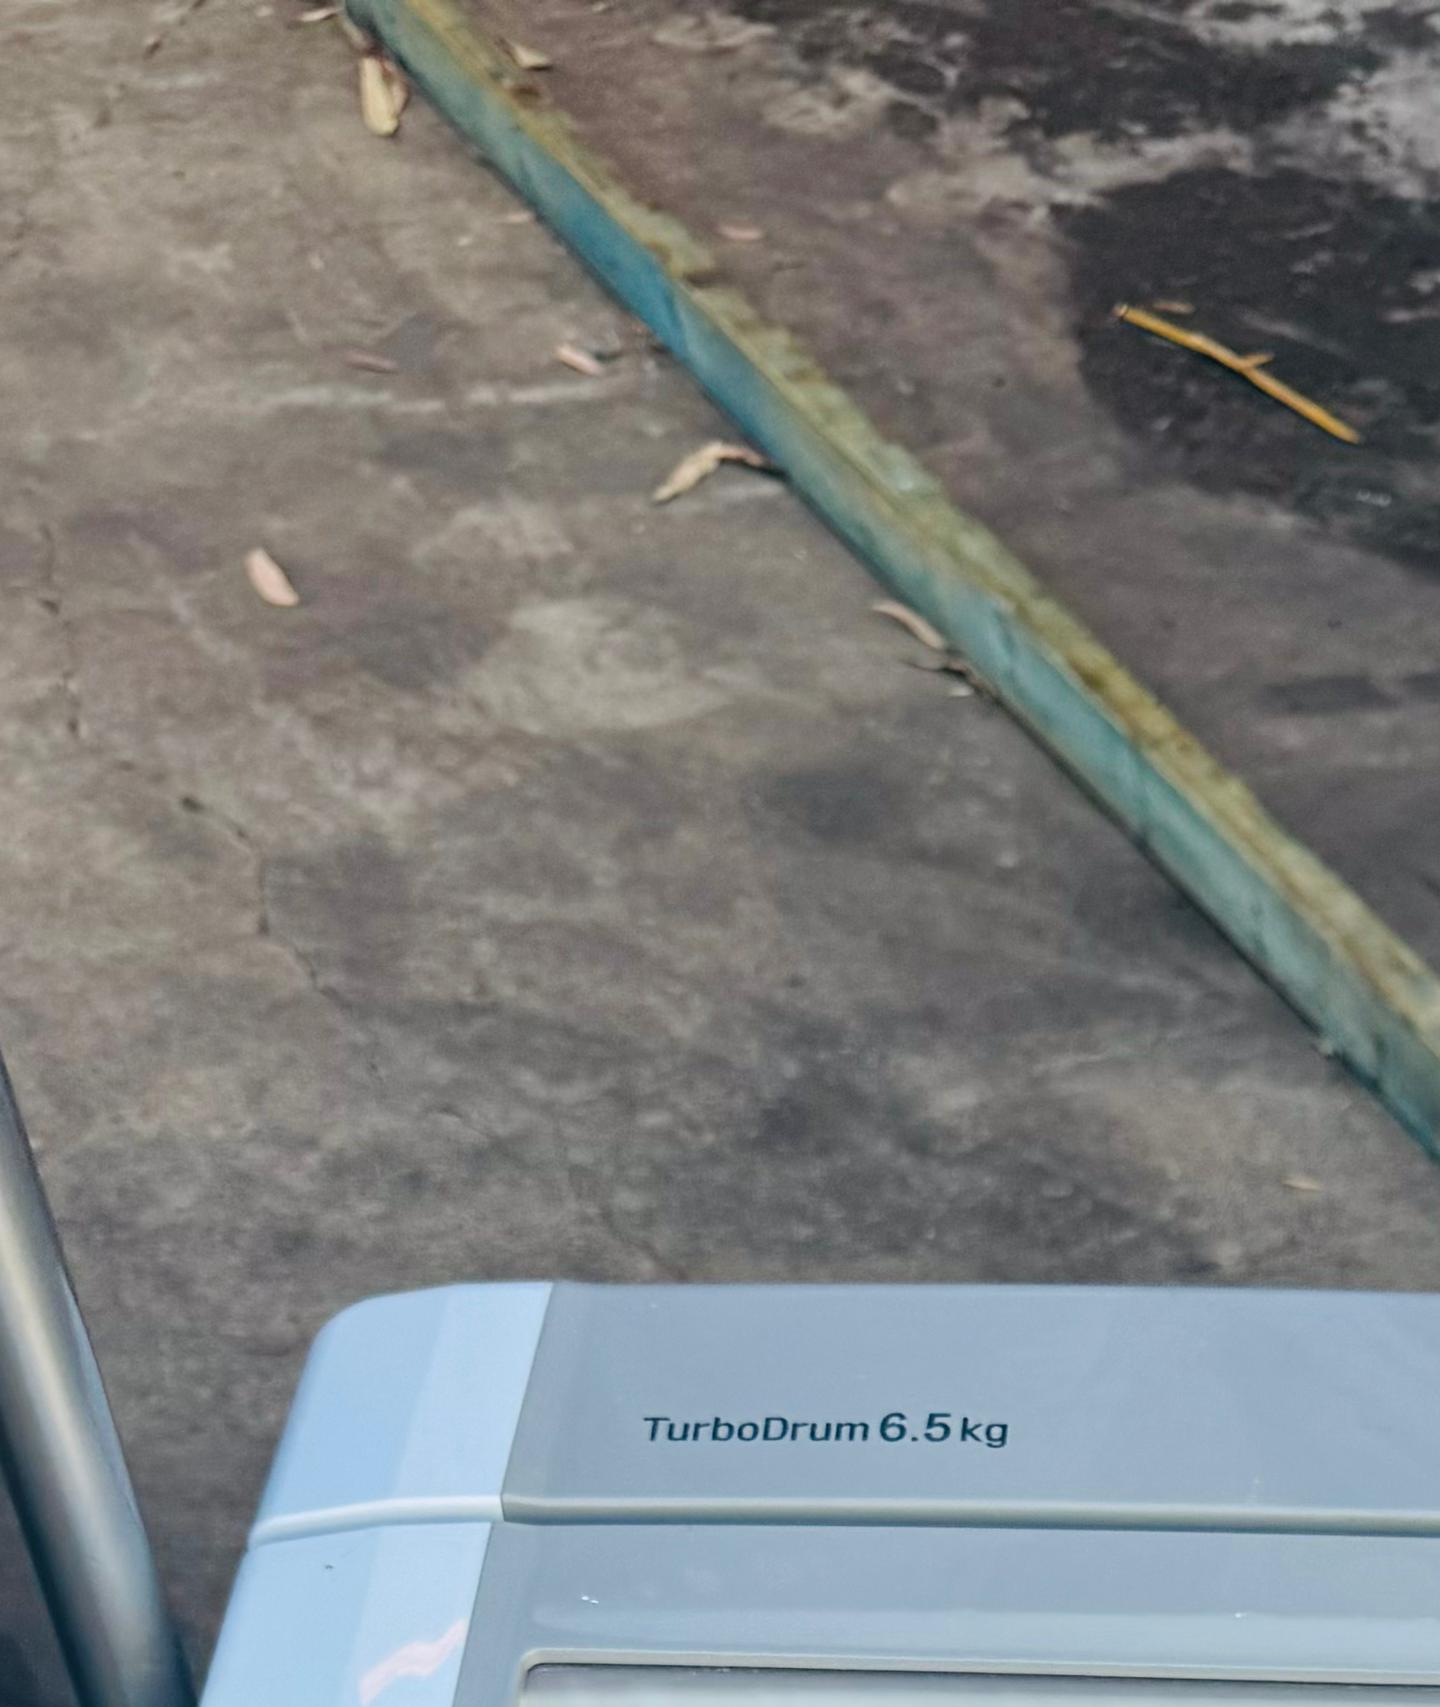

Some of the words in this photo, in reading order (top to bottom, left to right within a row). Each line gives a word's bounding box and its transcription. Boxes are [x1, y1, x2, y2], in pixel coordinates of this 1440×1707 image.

[644, 1417, 869, 1441] TurboDrum
[880, 1413, 951, 1442] 6.5
[961, 1417, 1008, 1448] kg
